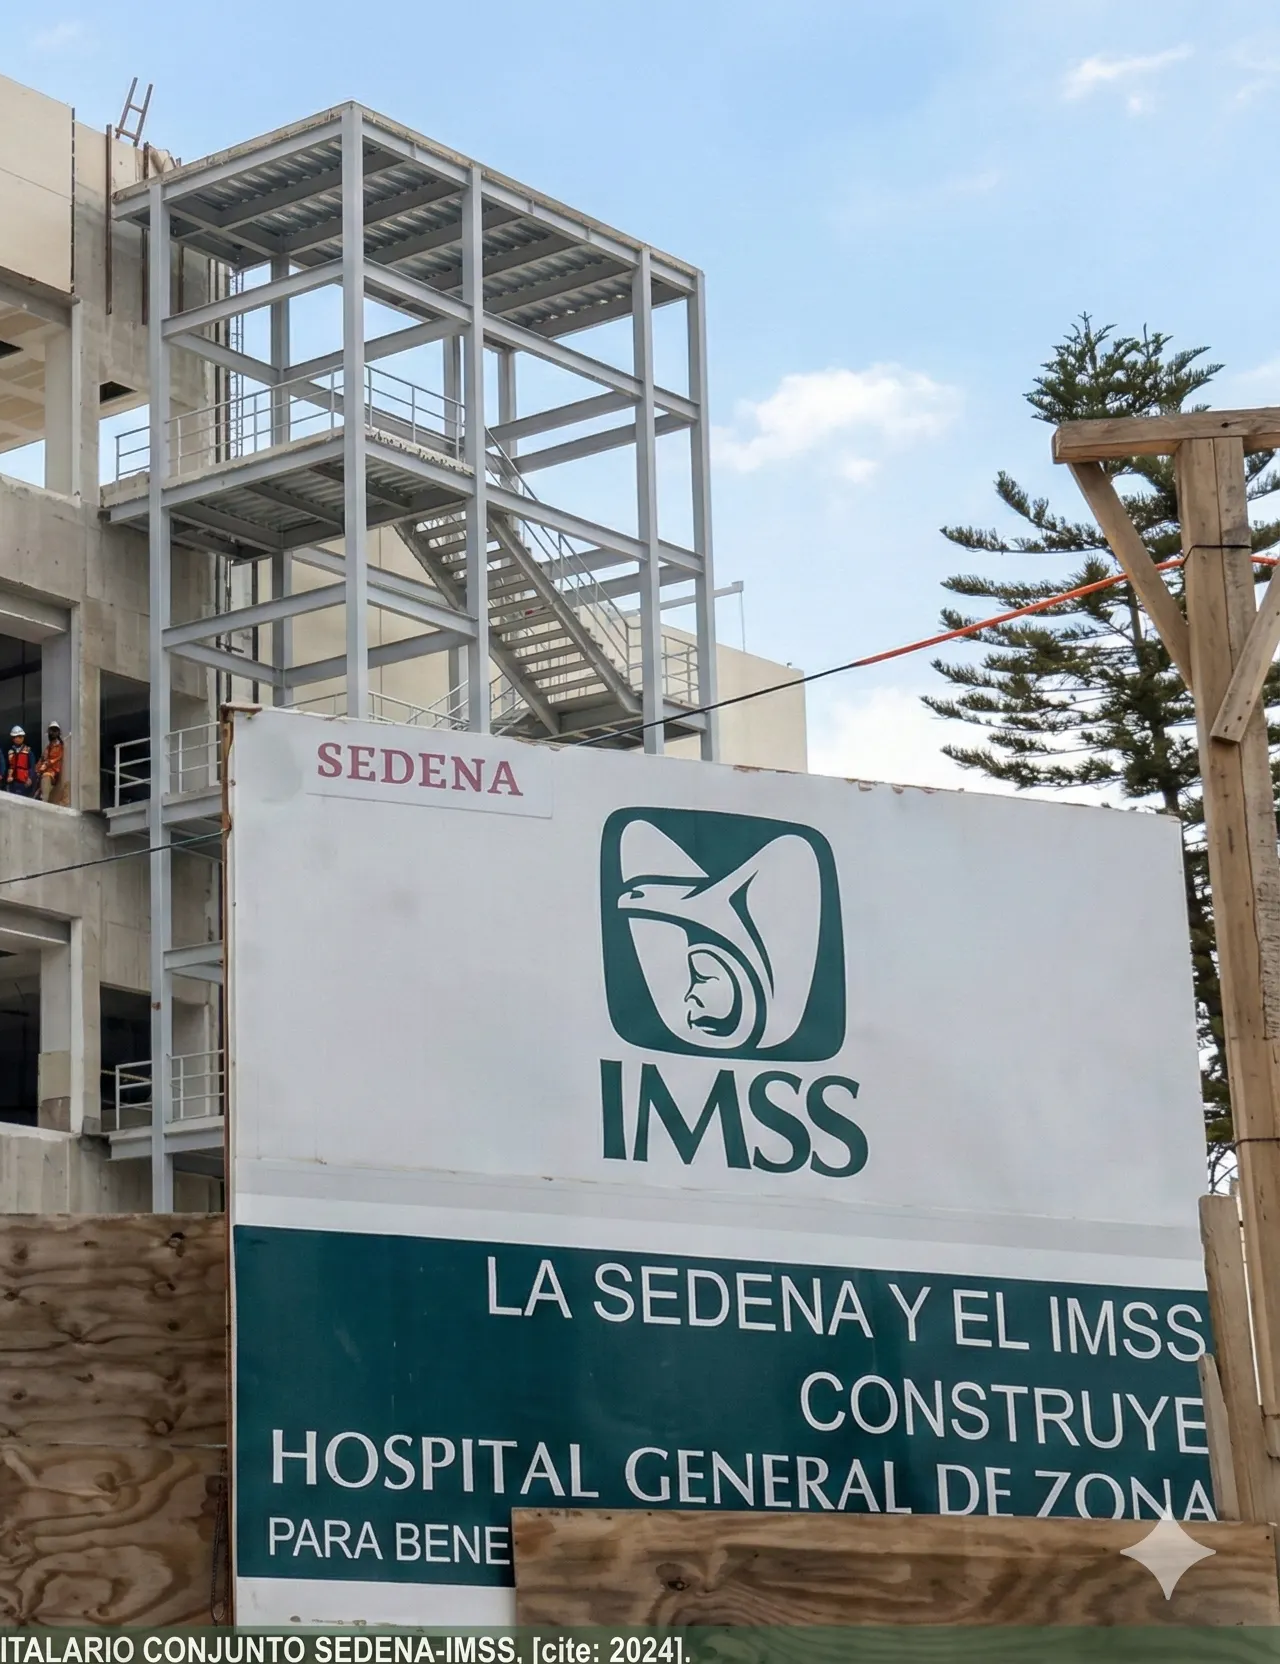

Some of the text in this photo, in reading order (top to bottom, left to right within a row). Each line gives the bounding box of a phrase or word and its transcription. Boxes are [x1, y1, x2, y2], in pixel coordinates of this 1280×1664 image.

[317, 741, 524, 797] SEDENA
[600, 1058, 869, 1177] IMSS
[487, 1256, 1207, 1362] LA SEDENA Y EL IMSS
[800, 1371, 1210, 1455] CONSTRUYE
[272, 1429, 1218, 1521] HOSPITAL GENERAL DE ZONA
[269, 1516, 511, 1565] PARA BENE
